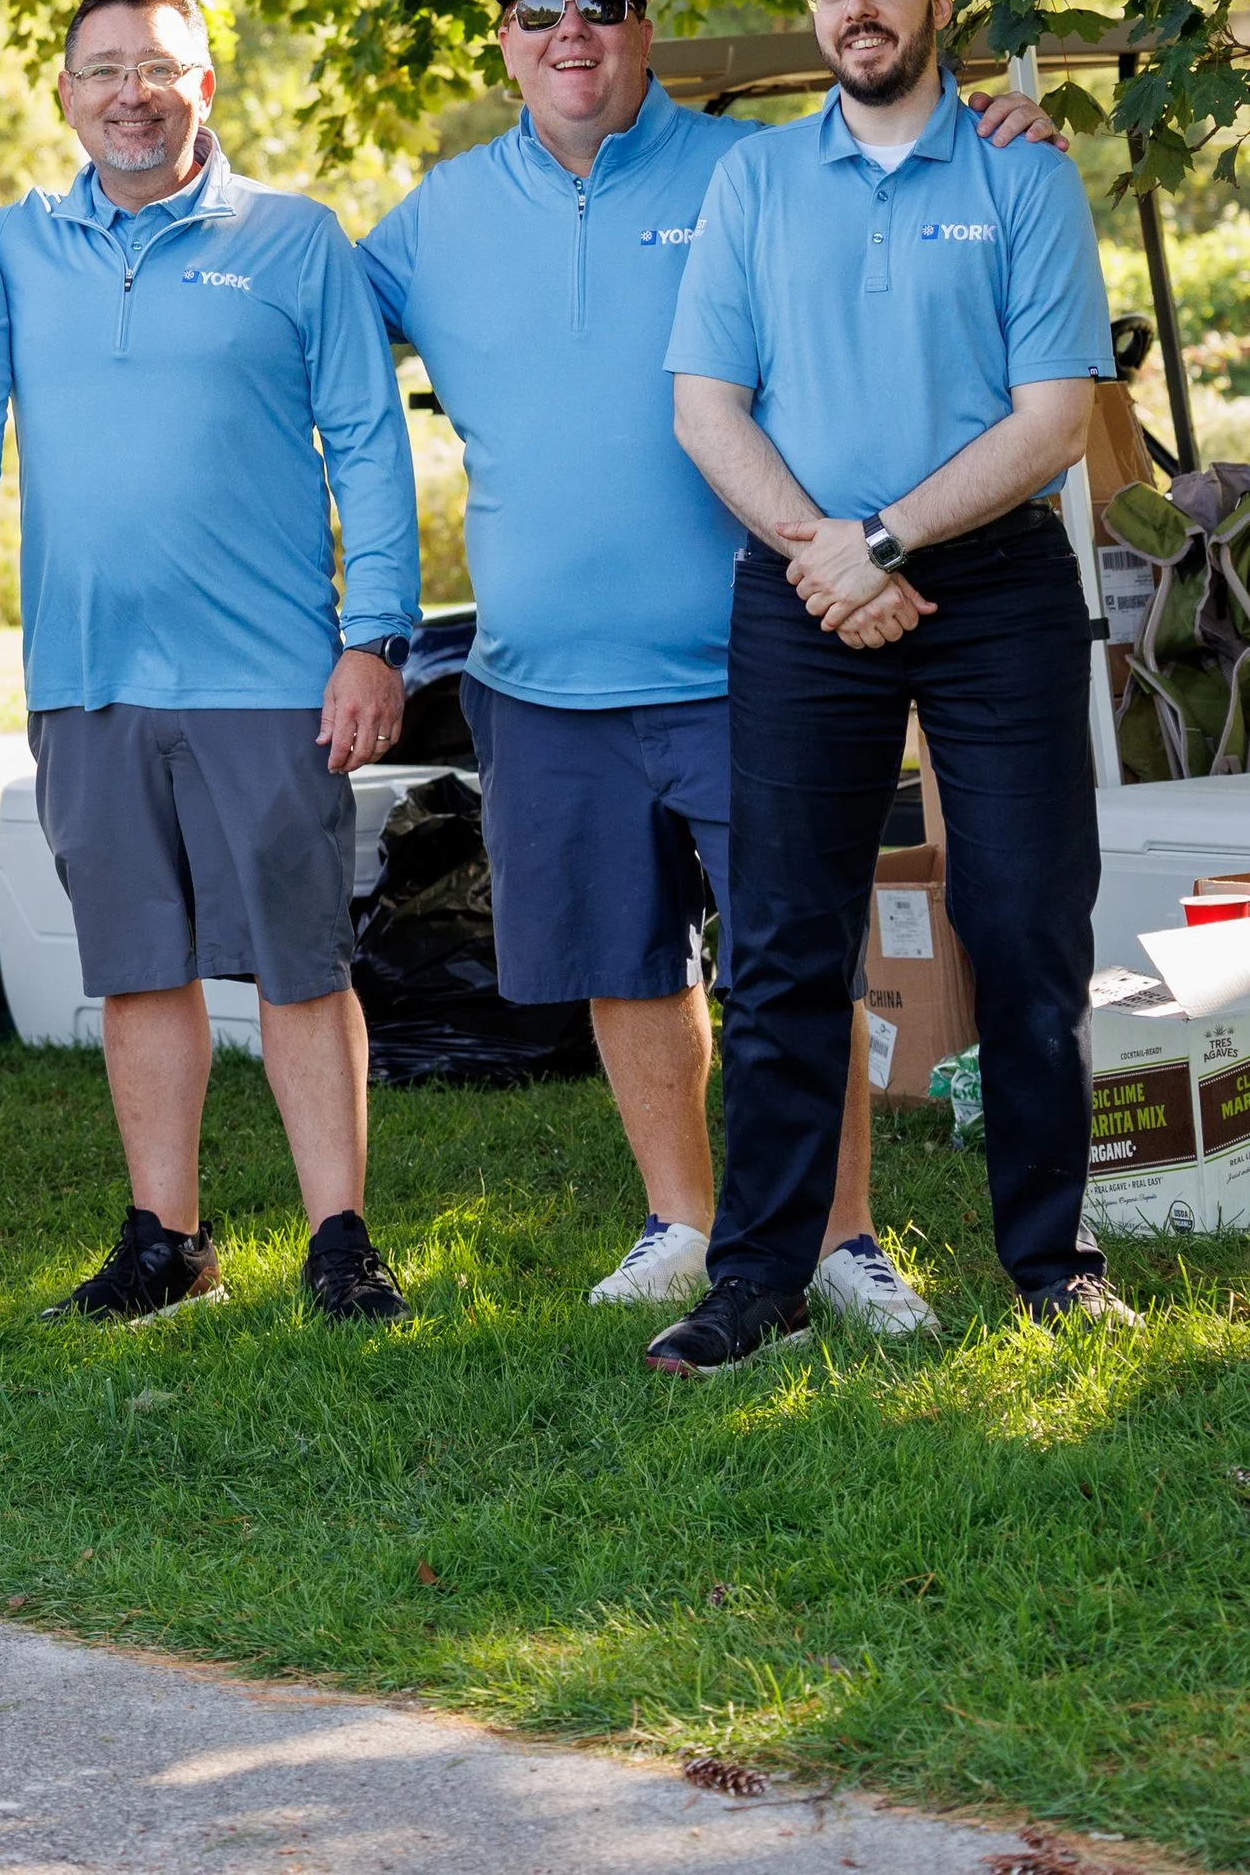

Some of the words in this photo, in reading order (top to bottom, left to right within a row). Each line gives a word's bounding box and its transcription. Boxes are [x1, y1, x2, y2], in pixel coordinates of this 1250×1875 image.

[941, 224, 997, 241] YORK
[201, 271, 251, 290] YORK
[870, 989, 903, 1008] CHINA
[1209, 1037, 1232, 1049] TRES
[1120, 1046, 1163, 1060] COCKTAIL-READY
[1203, 1047, 1239, 1063] AGAVES
[1114, 1082, 1145, 1106] LIME
[1137, 1104, 1167, 1130] MIX
[1089, 1140, 1133, 1163] RGANIC
[1229, 1155, 1244, 1167] REAL
[1094, 1185, 1108, 1194] REAL
[1109, 1181, 1127, 1192] AGAVE
[1131, 1178, 1147, 1189] REAL
[1148, 1176, 1162, 1187] EASY
